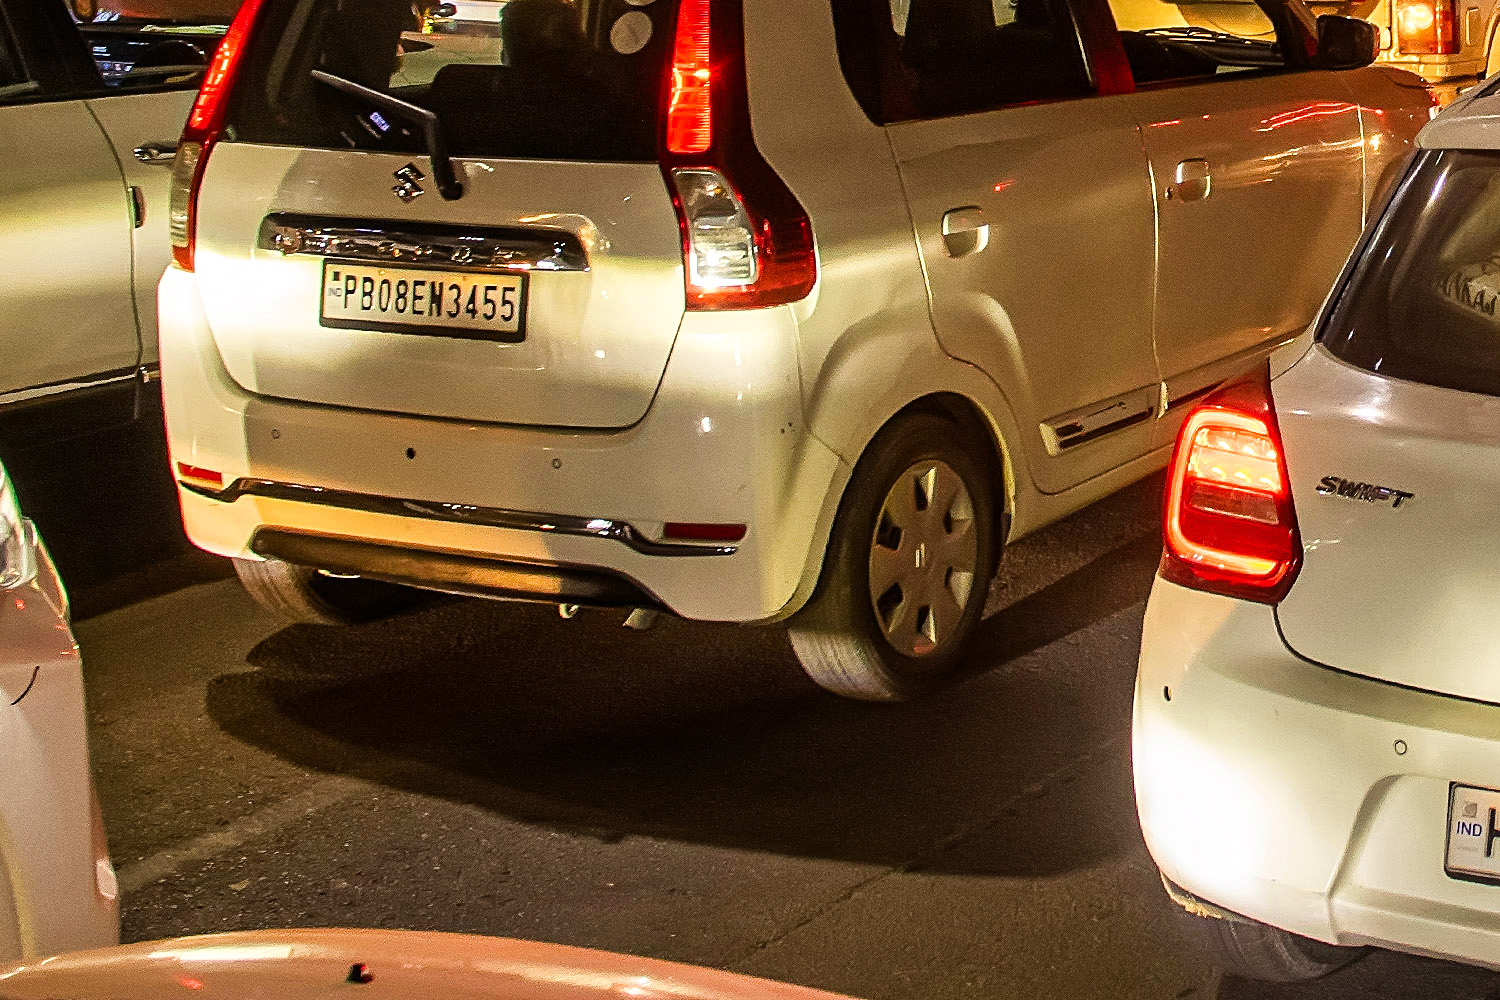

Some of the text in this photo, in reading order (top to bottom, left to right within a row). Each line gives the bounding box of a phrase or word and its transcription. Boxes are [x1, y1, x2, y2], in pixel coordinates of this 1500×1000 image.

[344, 274, 515, 322] PB08EN3455
[1315, 475, 1415, 508] SWIFT
[1456, 821, 1482, 837] IND
